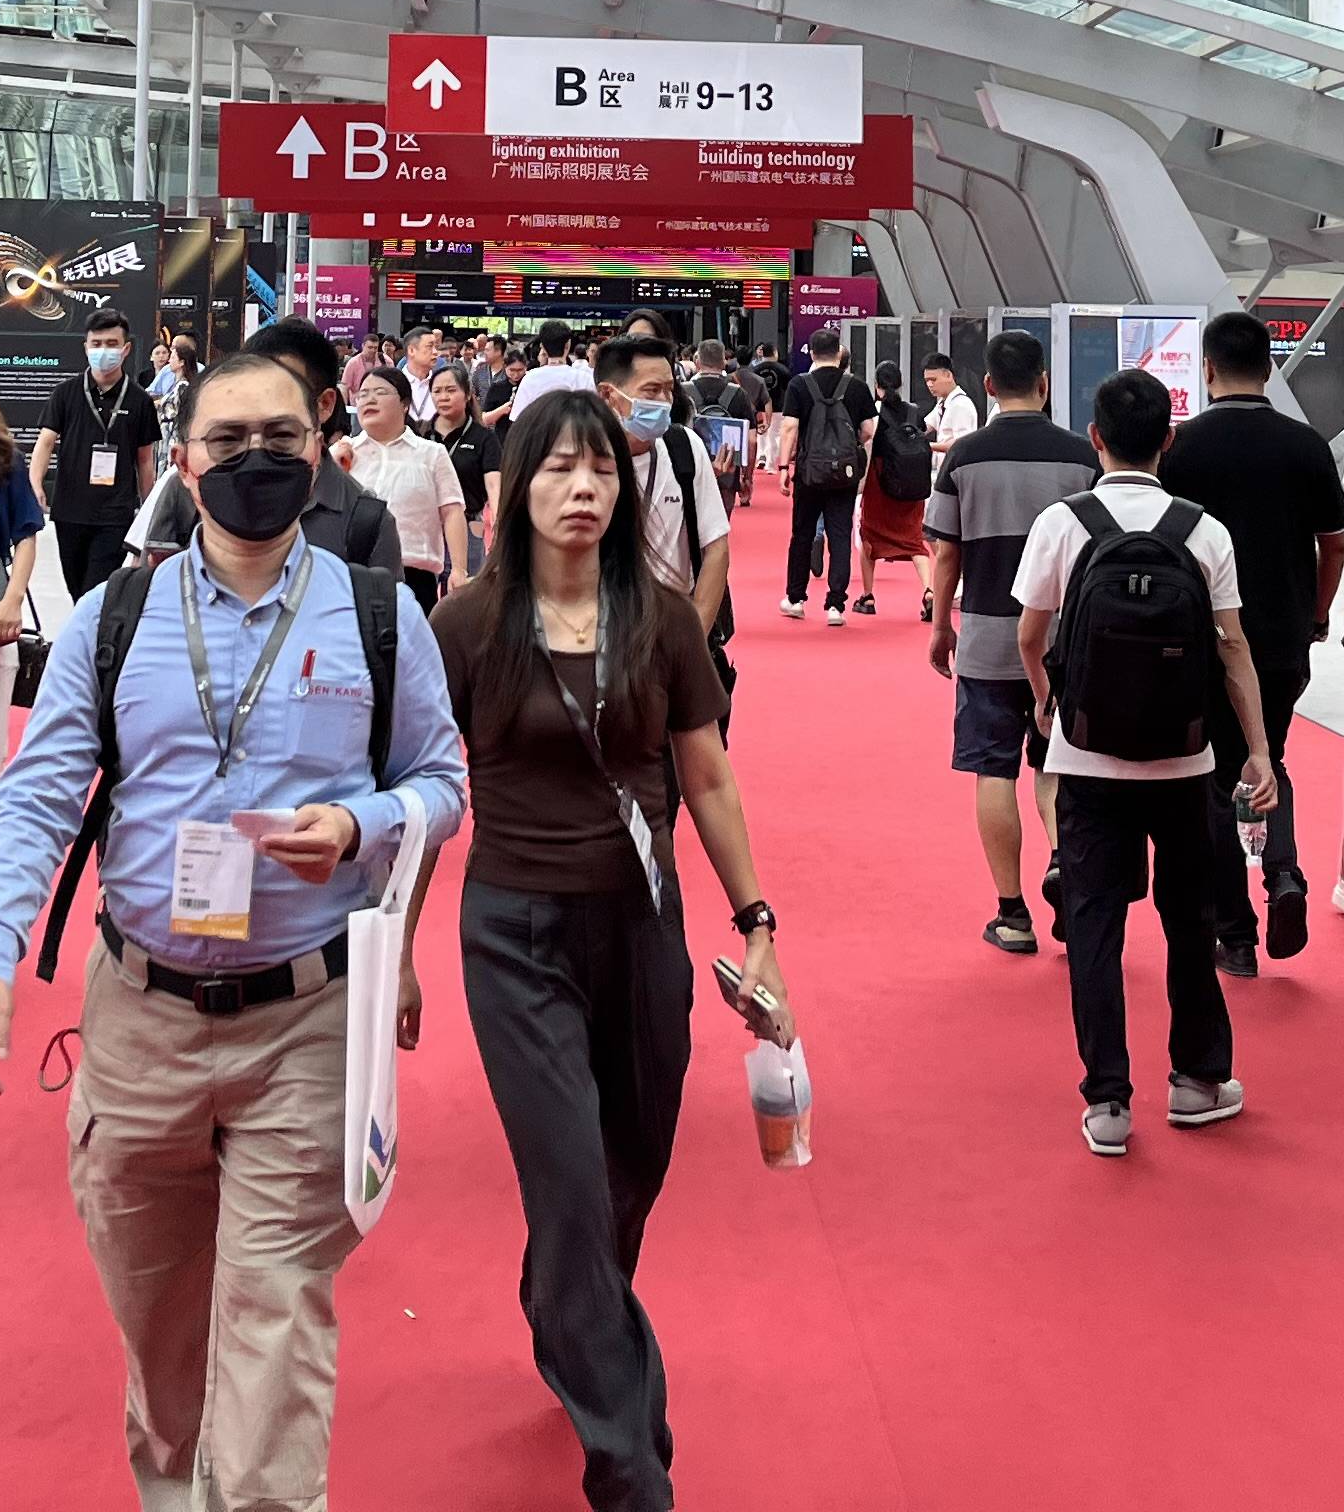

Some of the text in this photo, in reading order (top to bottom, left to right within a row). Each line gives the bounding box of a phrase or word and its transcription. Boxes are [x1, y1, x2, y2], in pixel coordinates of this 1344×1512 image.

[555, 66, 636, 107] B Area
[600, 85, 622, 108] 区
[659, 80, 690, 96] Hall
[658, 95, 689, 109] 展厅
[344, 121, 389, 181] B
[492, 142, 620, 160] lighting exhibition
[698, 148, 856, 171] building technology
[395, 162, 447, 182] Area
[491, 161, 649, 181] 广州国际照明展览会
[437, 213, 475, 229] Area
[62, 241, 146, 282] 光无限
[12, 356, 59, 366] Solutions
